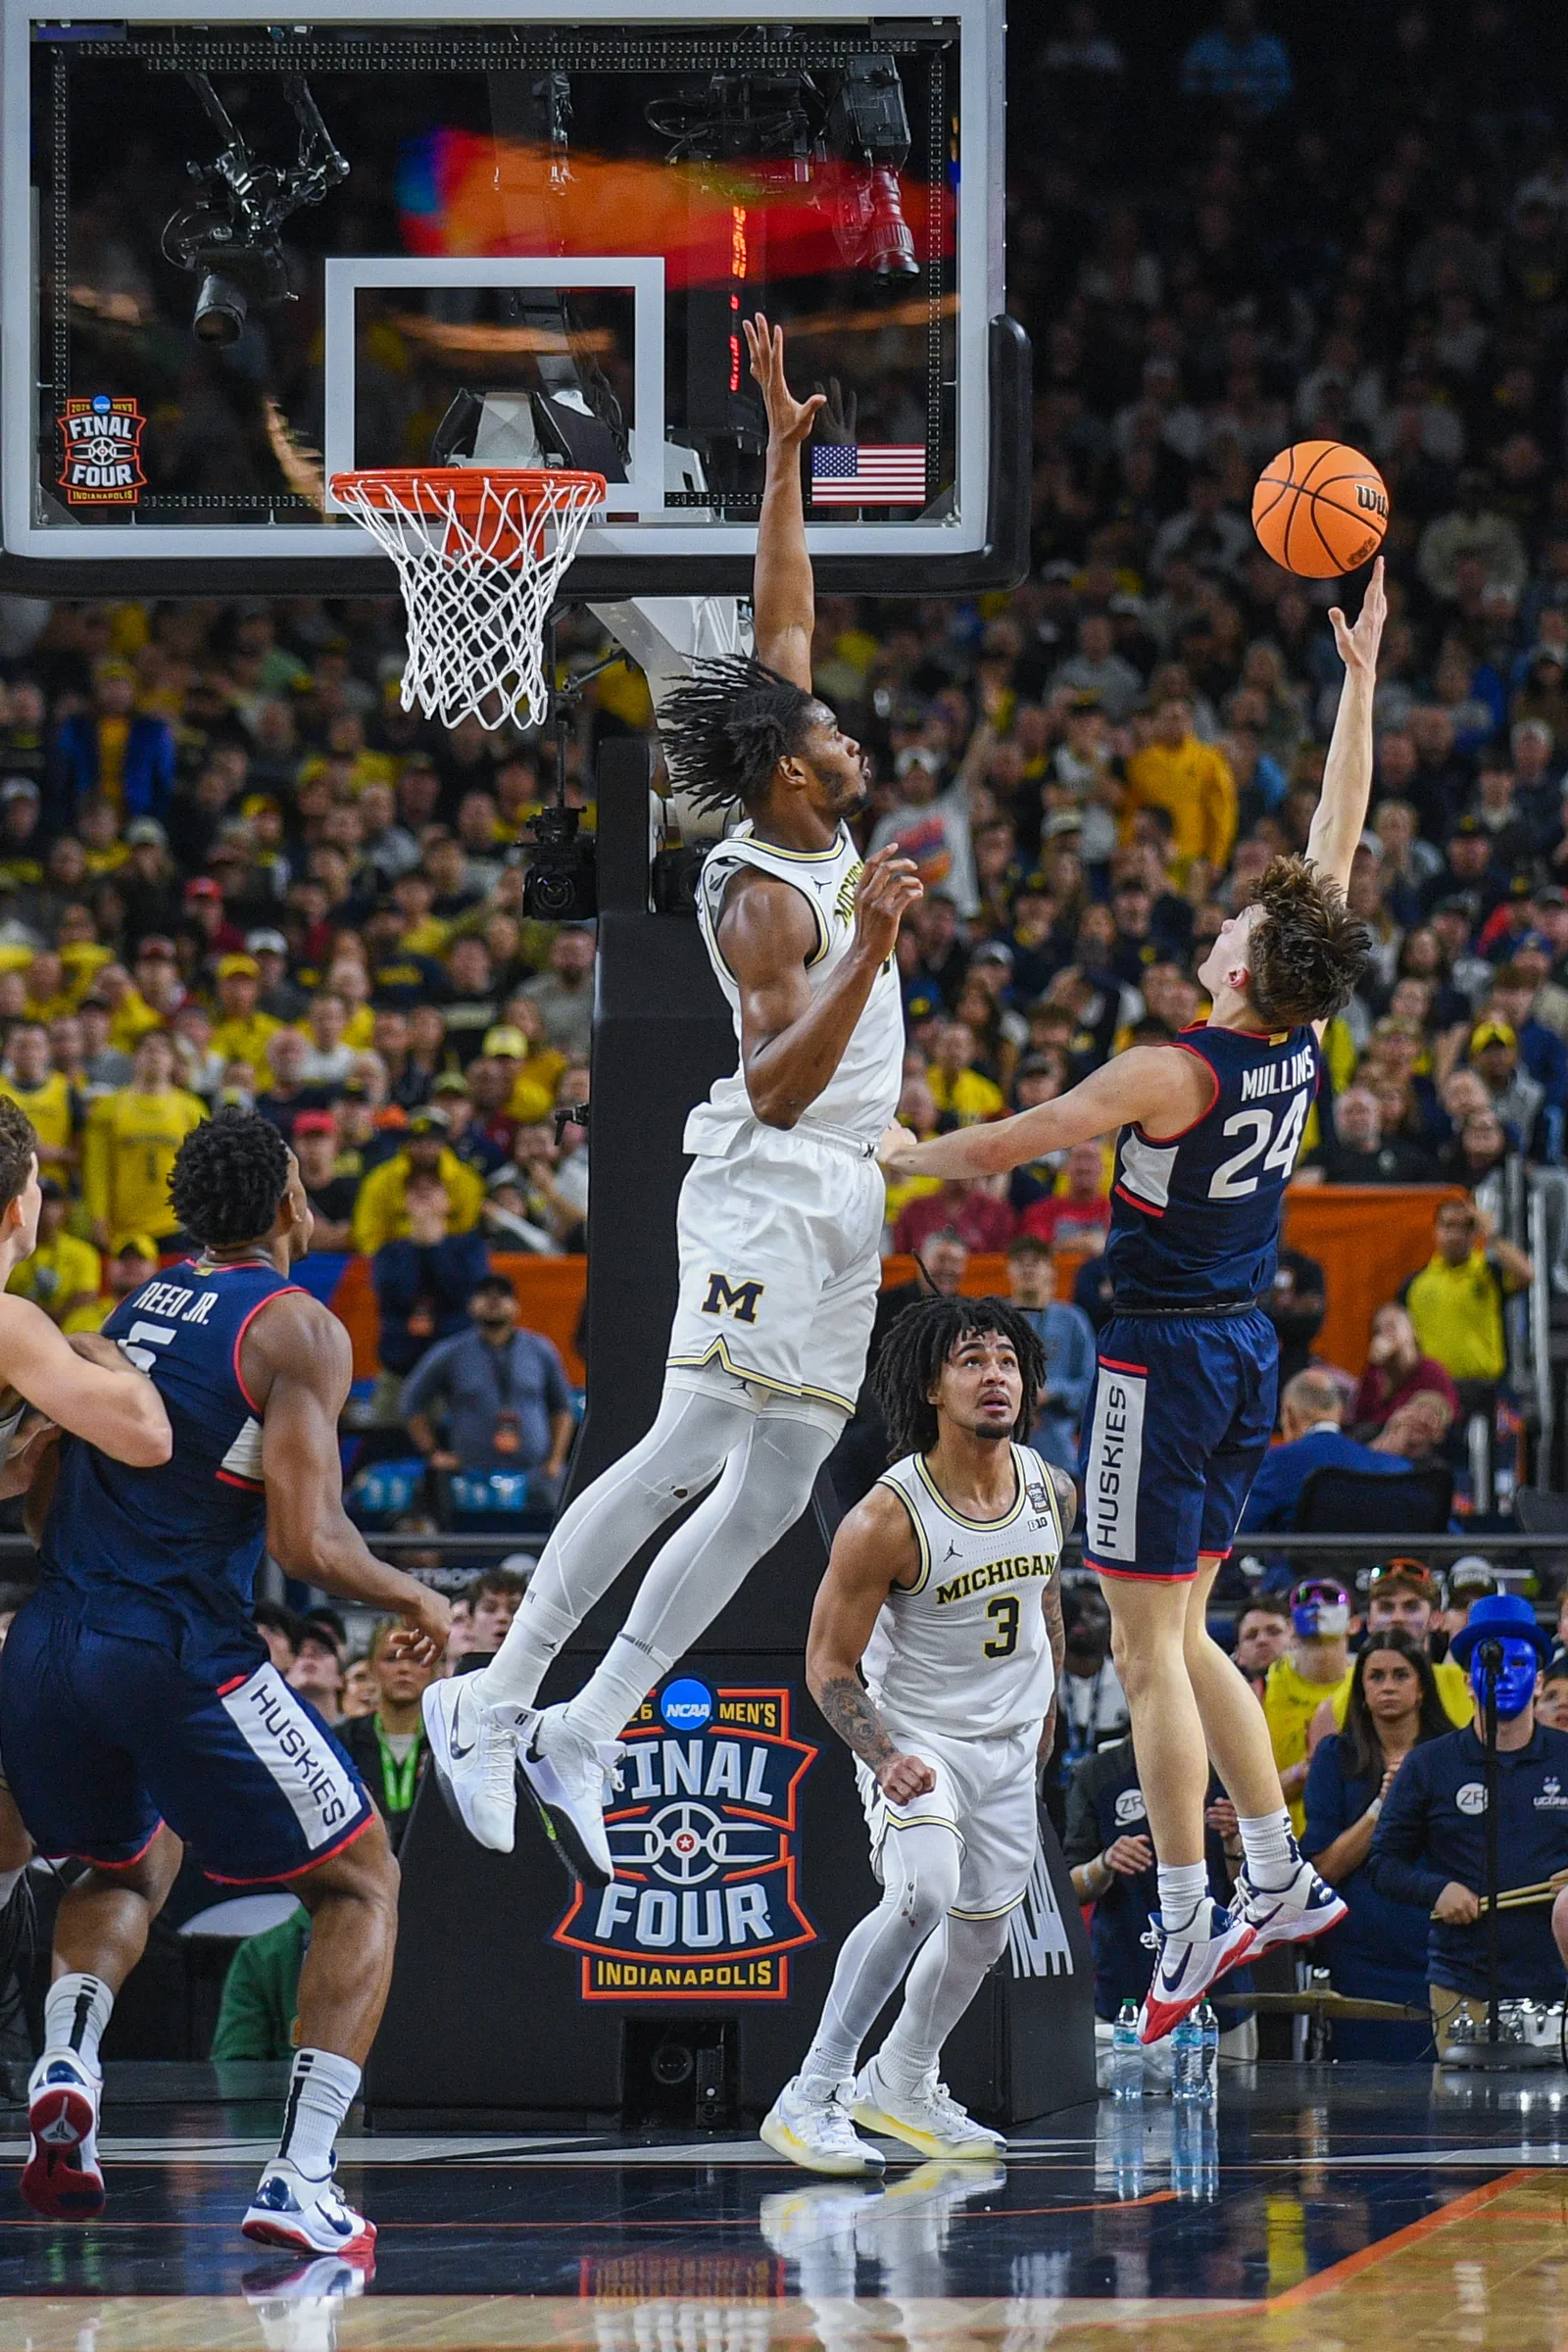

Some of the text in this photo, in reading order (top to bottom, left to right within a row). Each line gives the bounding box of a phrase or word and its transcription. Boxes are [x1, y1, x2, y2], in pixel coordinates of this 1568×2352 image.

[69, 416, 132, 439] FINAL
[72, 465, 133, 487] FOUR
[73, 491, 132, 500] INDIANAPOLIS
[1354, 484, 1389, 520] Wil
[1241, 1045, 1315, 1102] MULLINS
[1207, 1088, 1308, 1199] 24
[132, 1282, 219, 1325] REED JR.
[700, 1271, 766, 1324] M
[118, 1320, 177, 1378] 5
[1097, 1385, 1127, 1548] HUSKIES
[936, 1554, 1055, 1604] MICHIGAN
[983, 1594, 1020, 1658] 3
[665, 1703, 710, 1718] NCAA
[719, 1702, 776, 1727] MEN'S
[250, 1684, 346, 1826] HUSKIES
[595, 1882, 774, 1948] FOUR
[598, 1960, 772, 1985] INDIANAPOLIS
